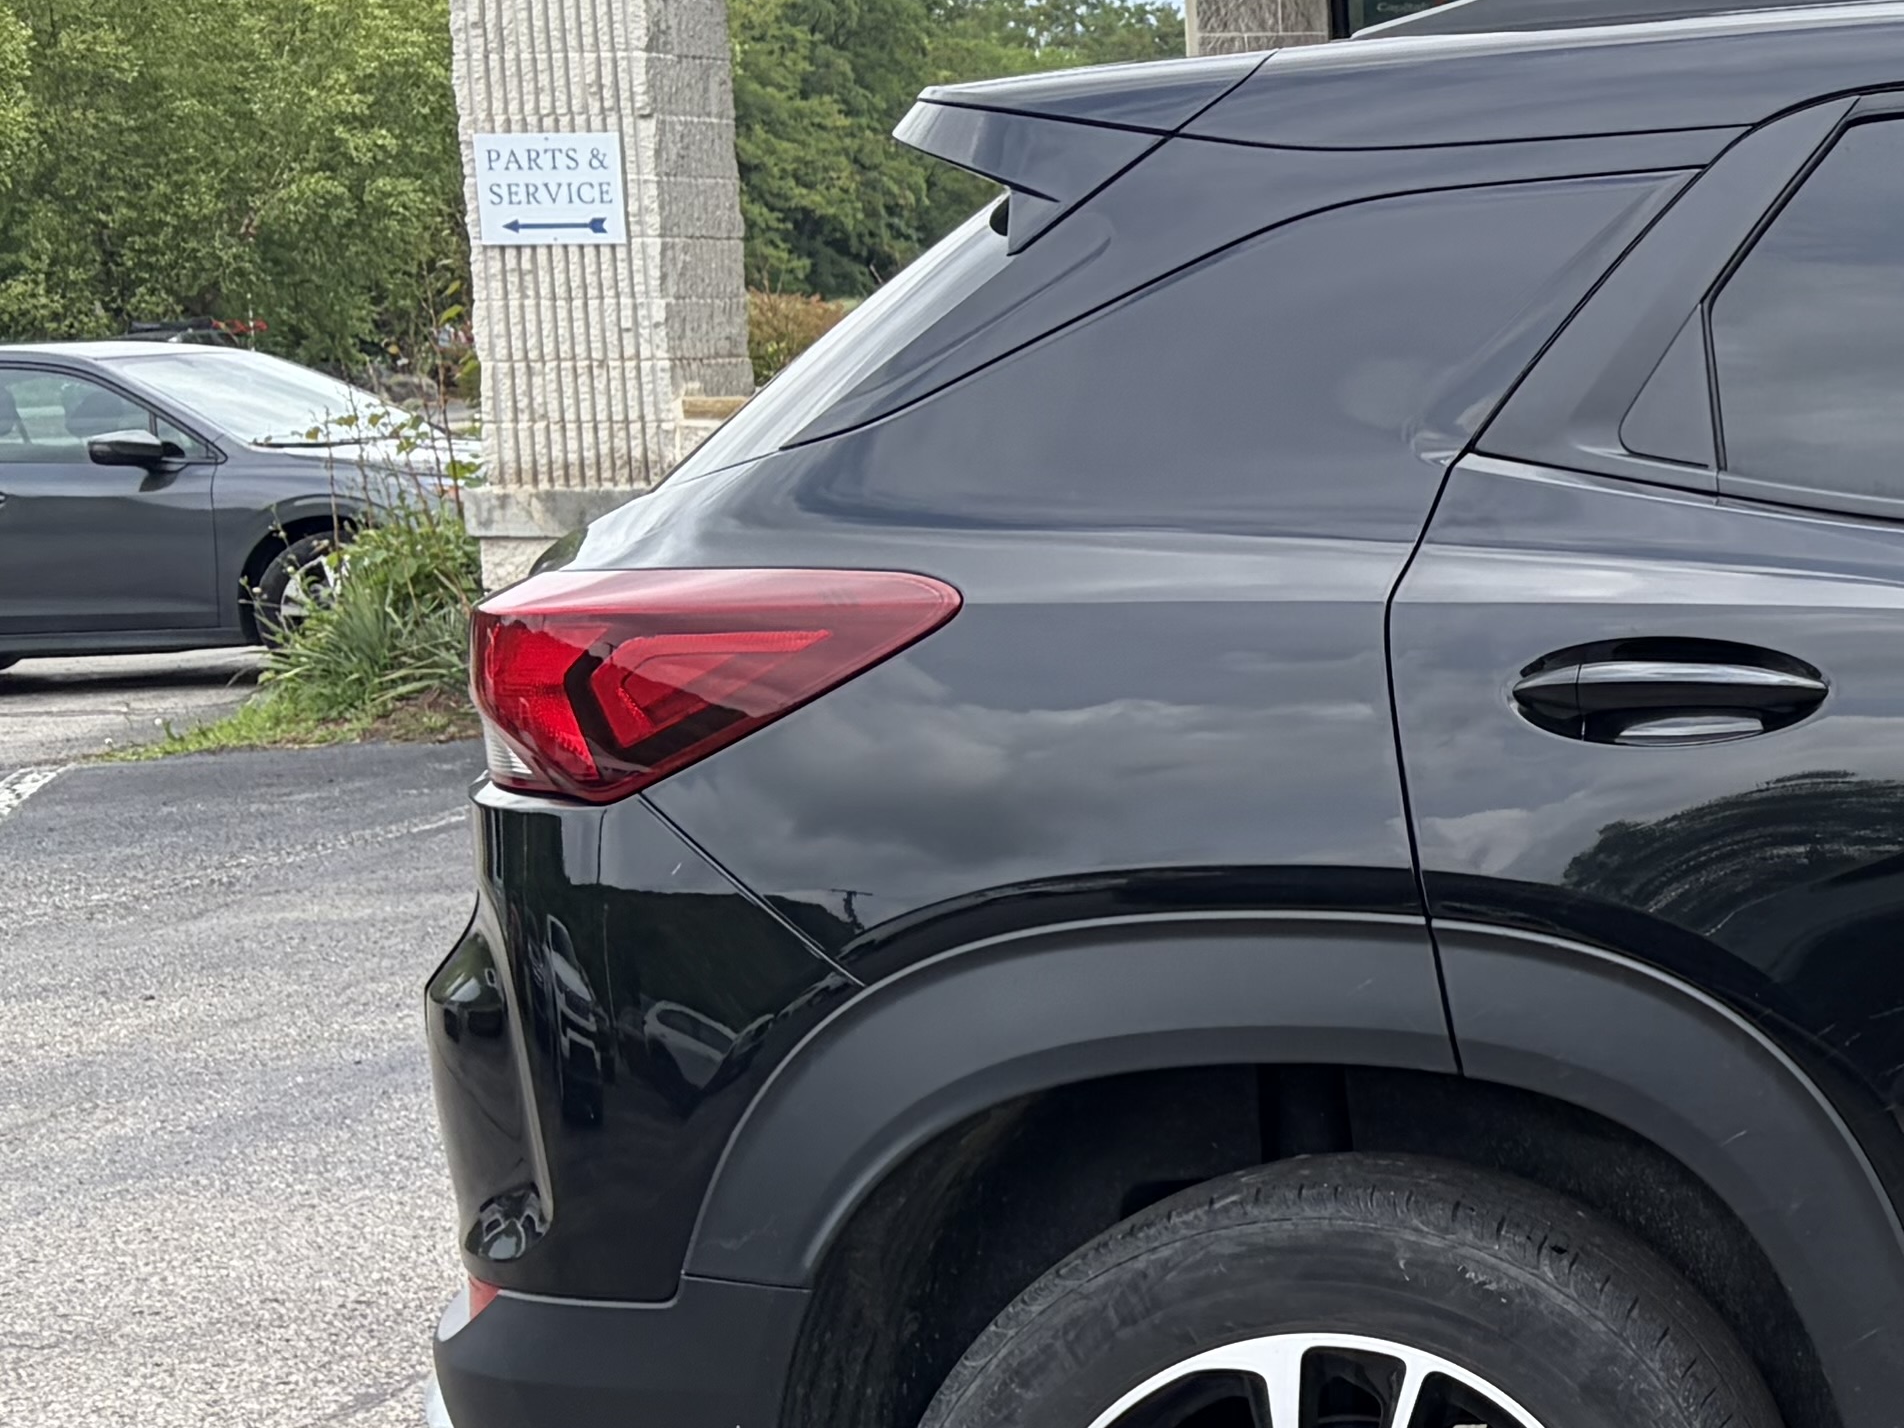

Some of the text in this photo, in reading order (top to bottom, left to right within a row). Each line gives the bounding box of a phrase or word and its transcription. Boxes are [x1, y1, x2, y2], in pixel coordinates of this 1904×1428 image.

[485, 146, 609, 171] PARTS &
[488, 181, 614, 206] SERVICE
